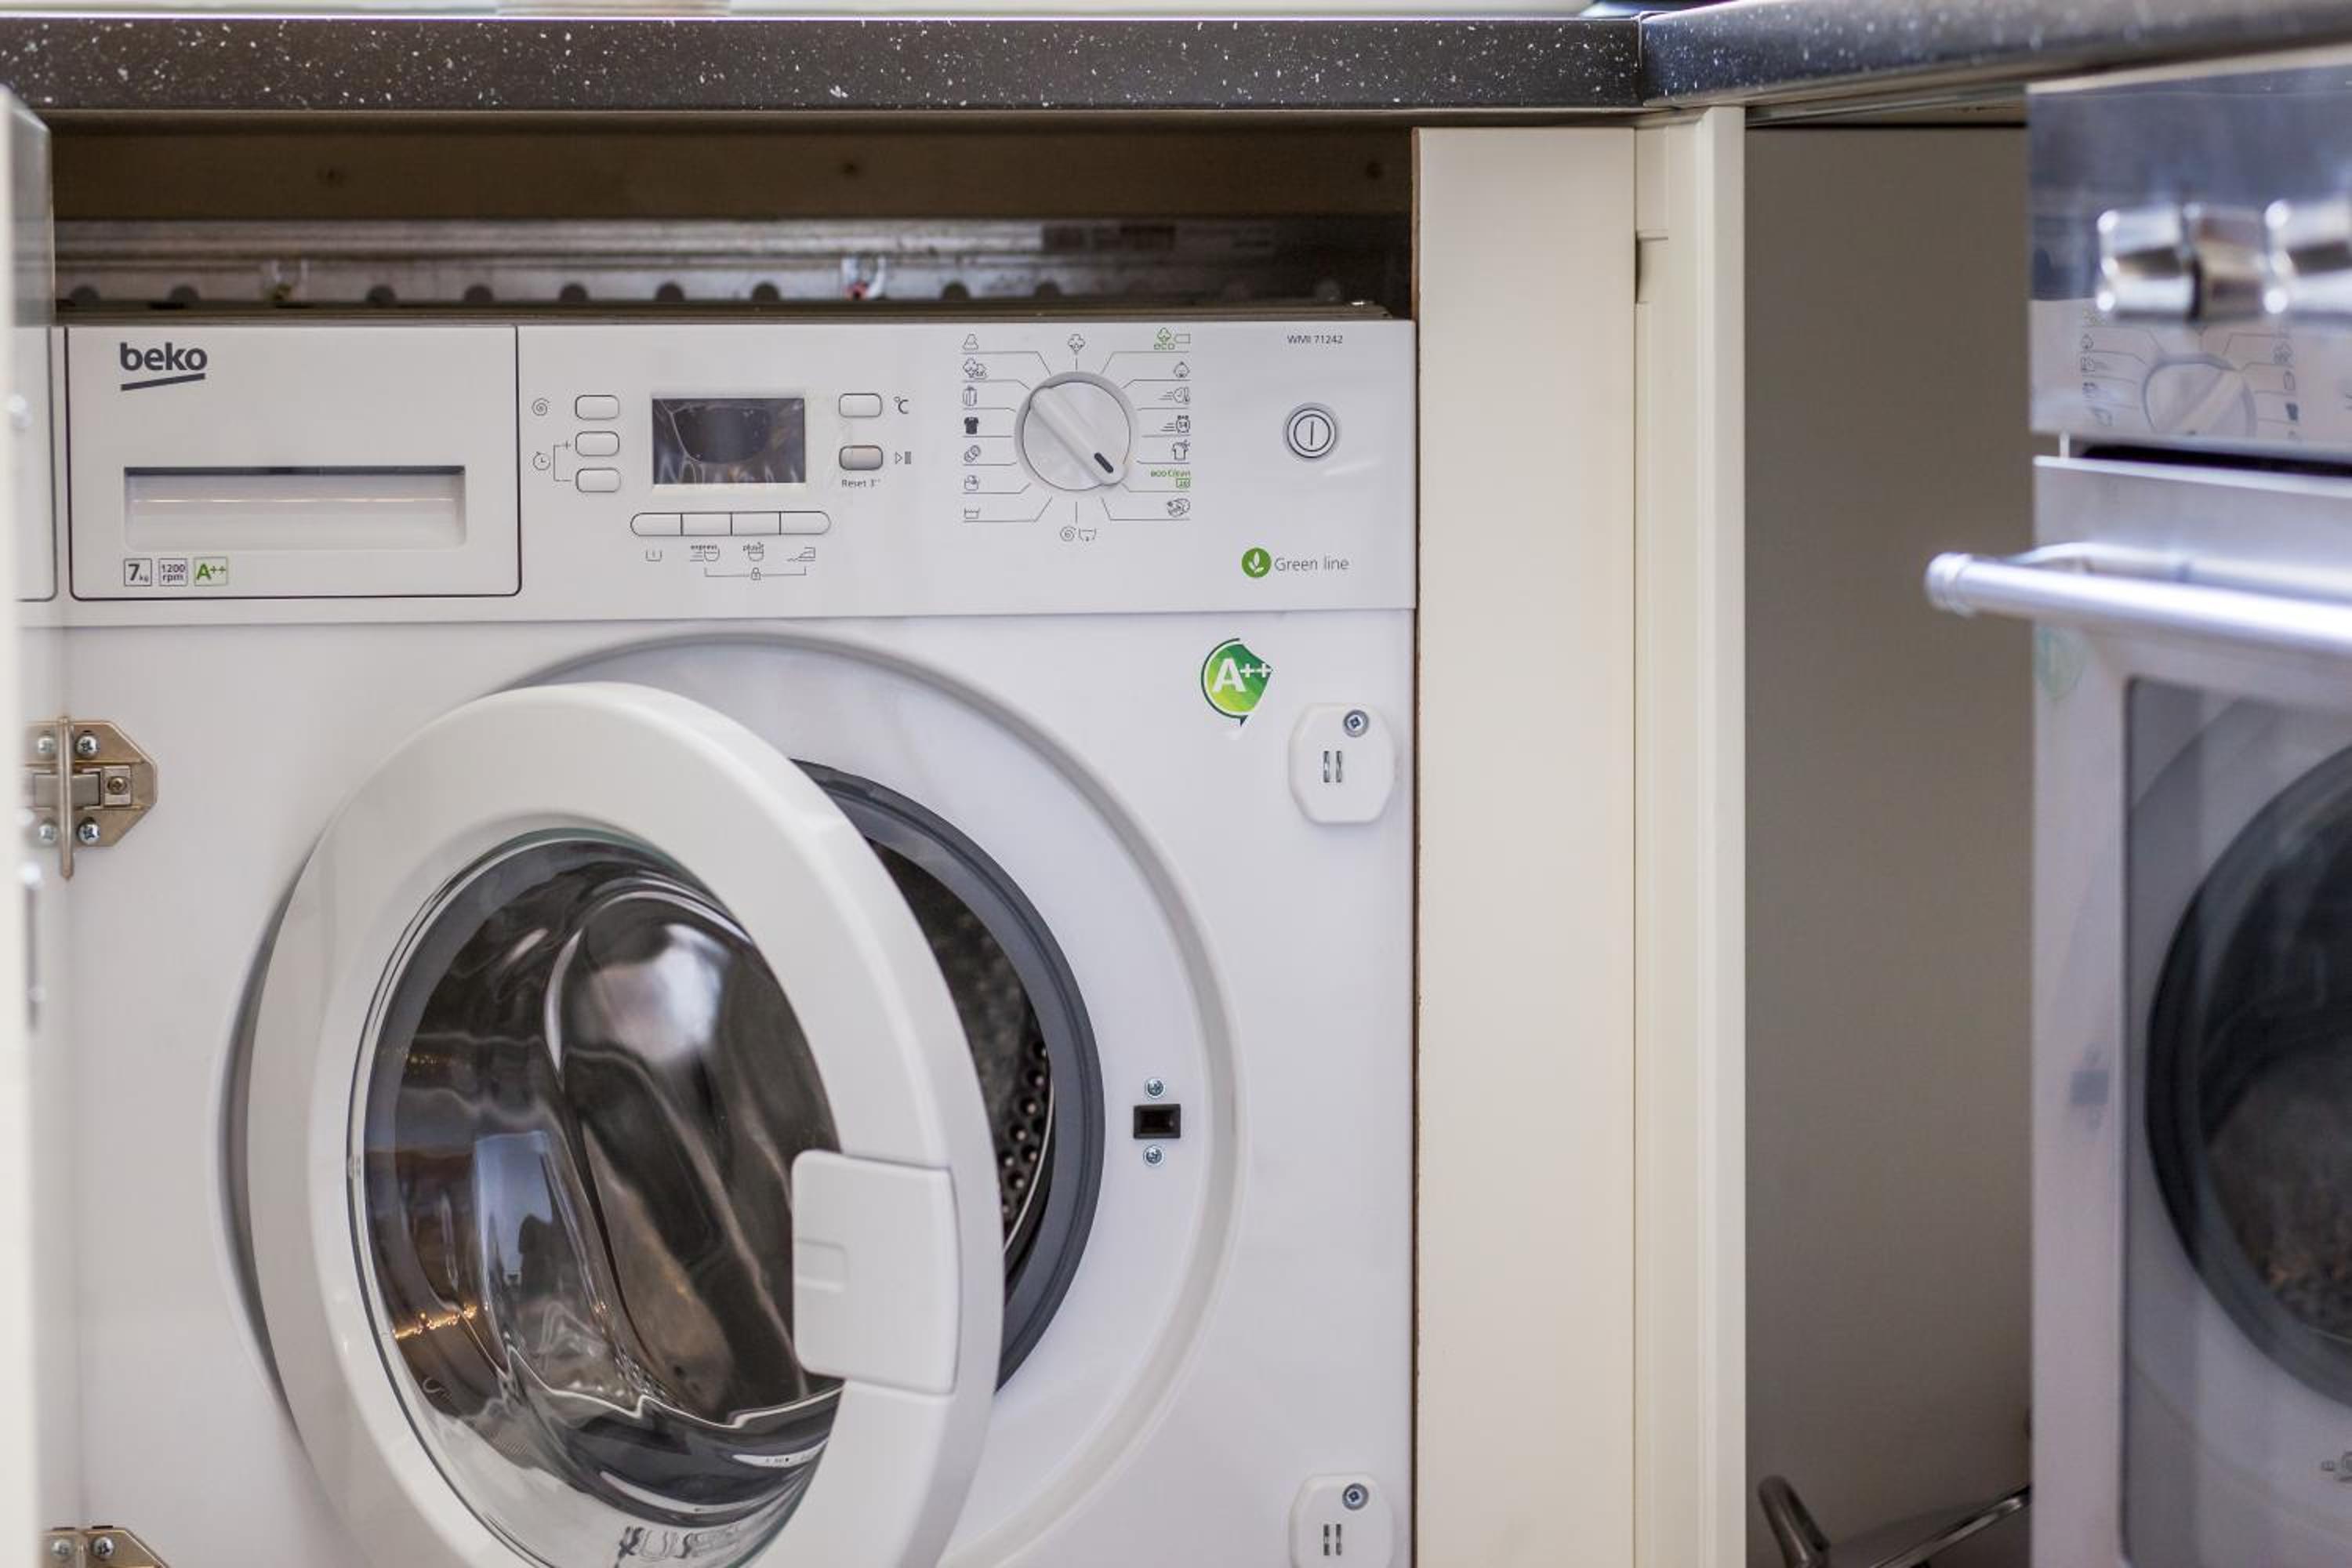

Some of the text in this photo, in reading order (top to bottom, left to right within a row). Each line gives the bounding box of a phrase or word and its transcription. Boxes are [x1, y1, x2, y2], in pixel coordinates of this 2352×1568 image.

[1313, 335, 1343, 344] 71242
[120, 342, 207, 371] beko
[841, 479, 866, 488] Reset
[162, 564, 186, 573] 1200
[1274, 555, 1349, 572] Green line
[162, 573, 185, 583] rpm
[195, 563, 226, 581] A++
[1212, 657, 1272, 692] A++
